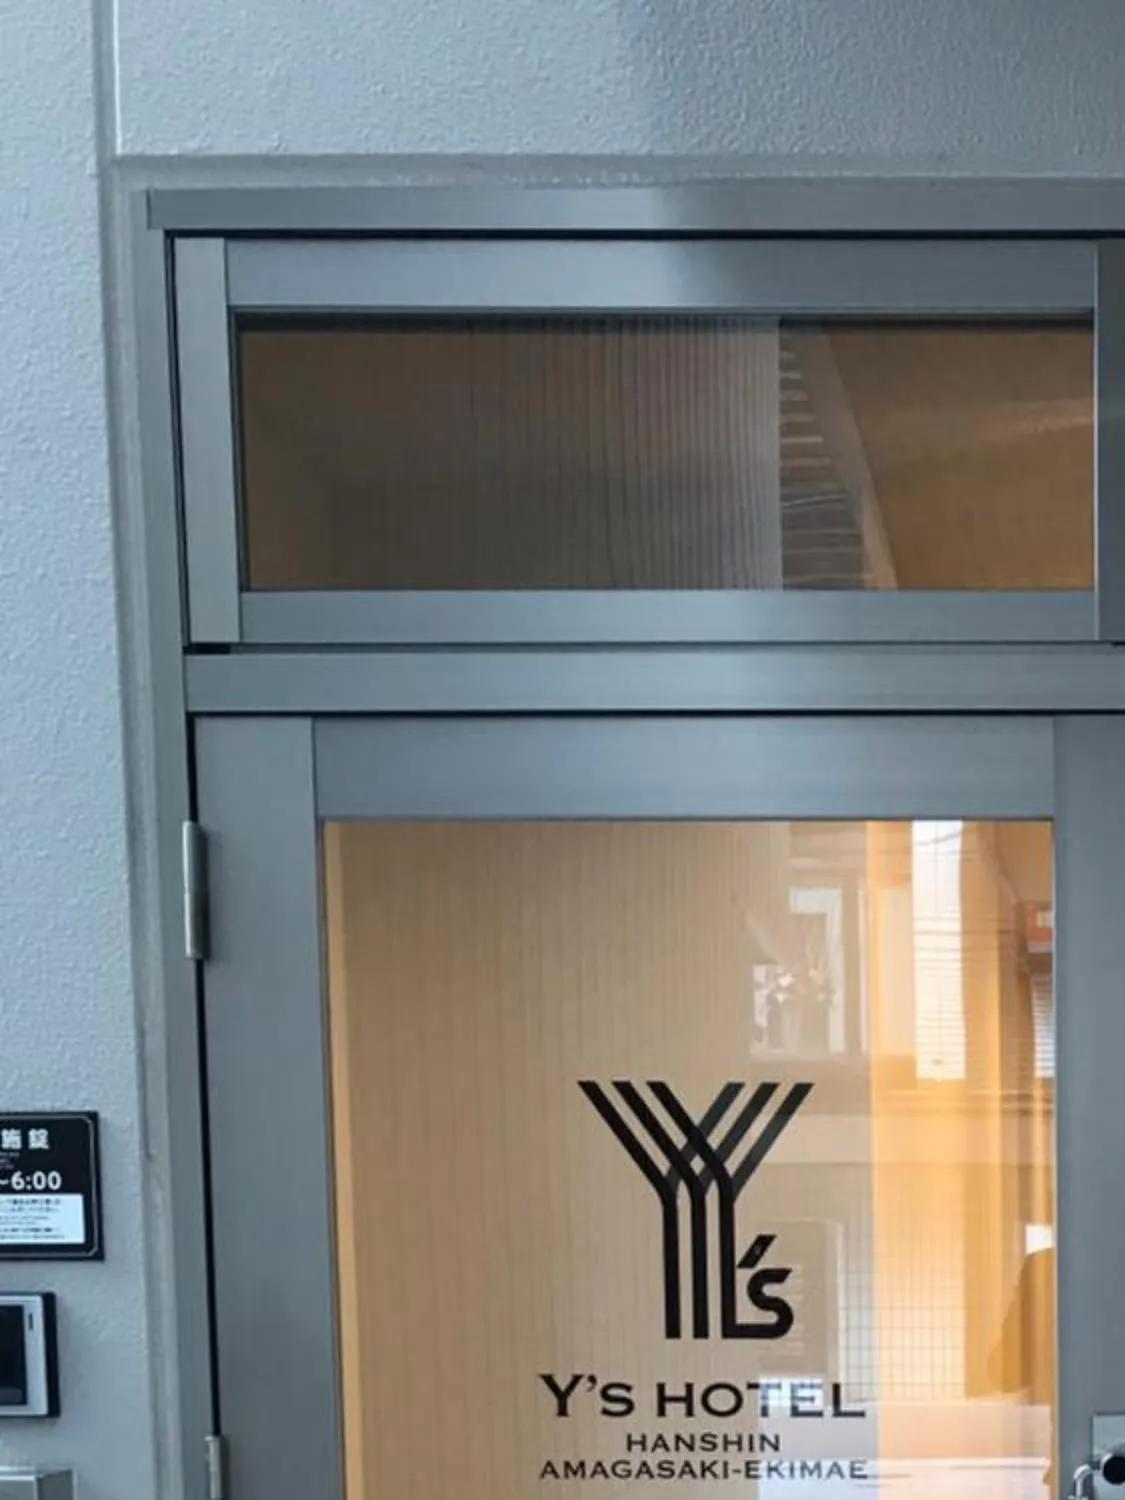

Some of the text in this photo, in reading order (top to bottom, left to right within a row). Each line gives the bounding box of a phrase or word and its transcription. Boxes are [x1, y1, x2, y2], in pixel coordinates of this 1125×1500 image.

[656, 1382, 867, 1418] HOTEL
[626, 1432, 781, 1453] HANSHIN
[538, 1459, 869, 1481] AMAGASAKI-EKIMAE
